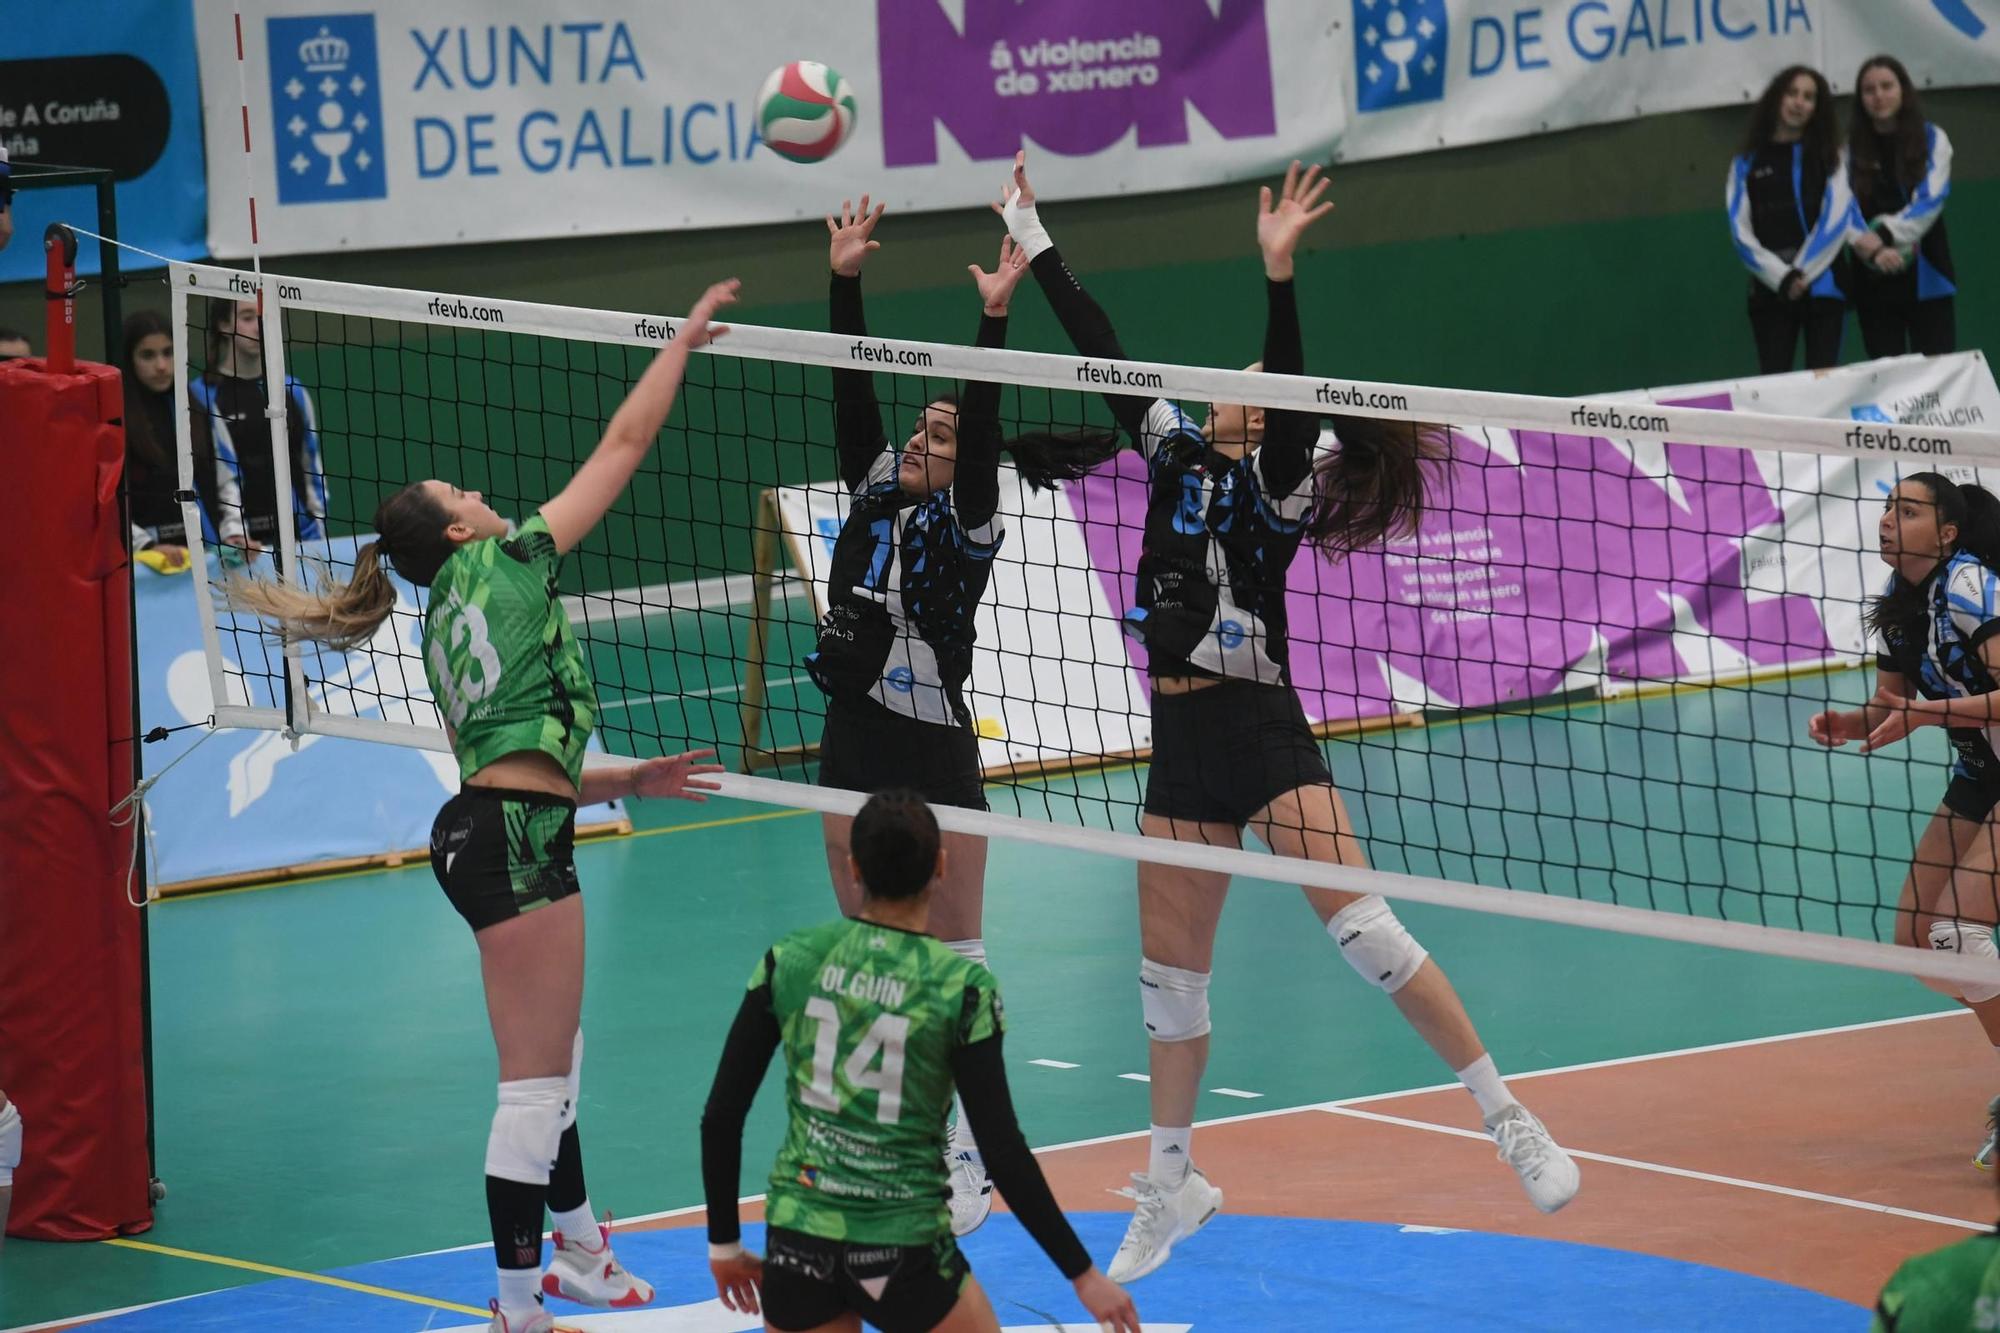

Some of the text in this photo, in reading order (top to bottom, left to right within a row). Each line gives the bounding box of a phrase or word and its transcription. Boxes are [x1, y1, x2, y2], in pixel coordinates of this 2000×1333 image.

[409, 21, 646, 91] XUNTA
[990, 32, 1161, 69] á violencia
[1470, 0, 1812, 77] DE GALICIA
[995, 61, 1158, 96] de xénero
[22, 103, 40, 126] A
[44, 99, 120, 124] Coruña
[414, 114, 499, 178] DE
[428, 298, 504, 322] rfevb.com
[851, 341, 933, 367] rfevb.com
[1077, 362, 1163, 388] rfevb.com
[1316, 383, 1408, 410] rfevb.com
[1570, 405, 1669, 432] rfevb.com
[1845, 426, 1952, 455] rfevb.com
[428, 604, 501, 729] 13
[821, 963, 906, 1009] OLGUÍN
[800, 996, 910, 1124] 14
